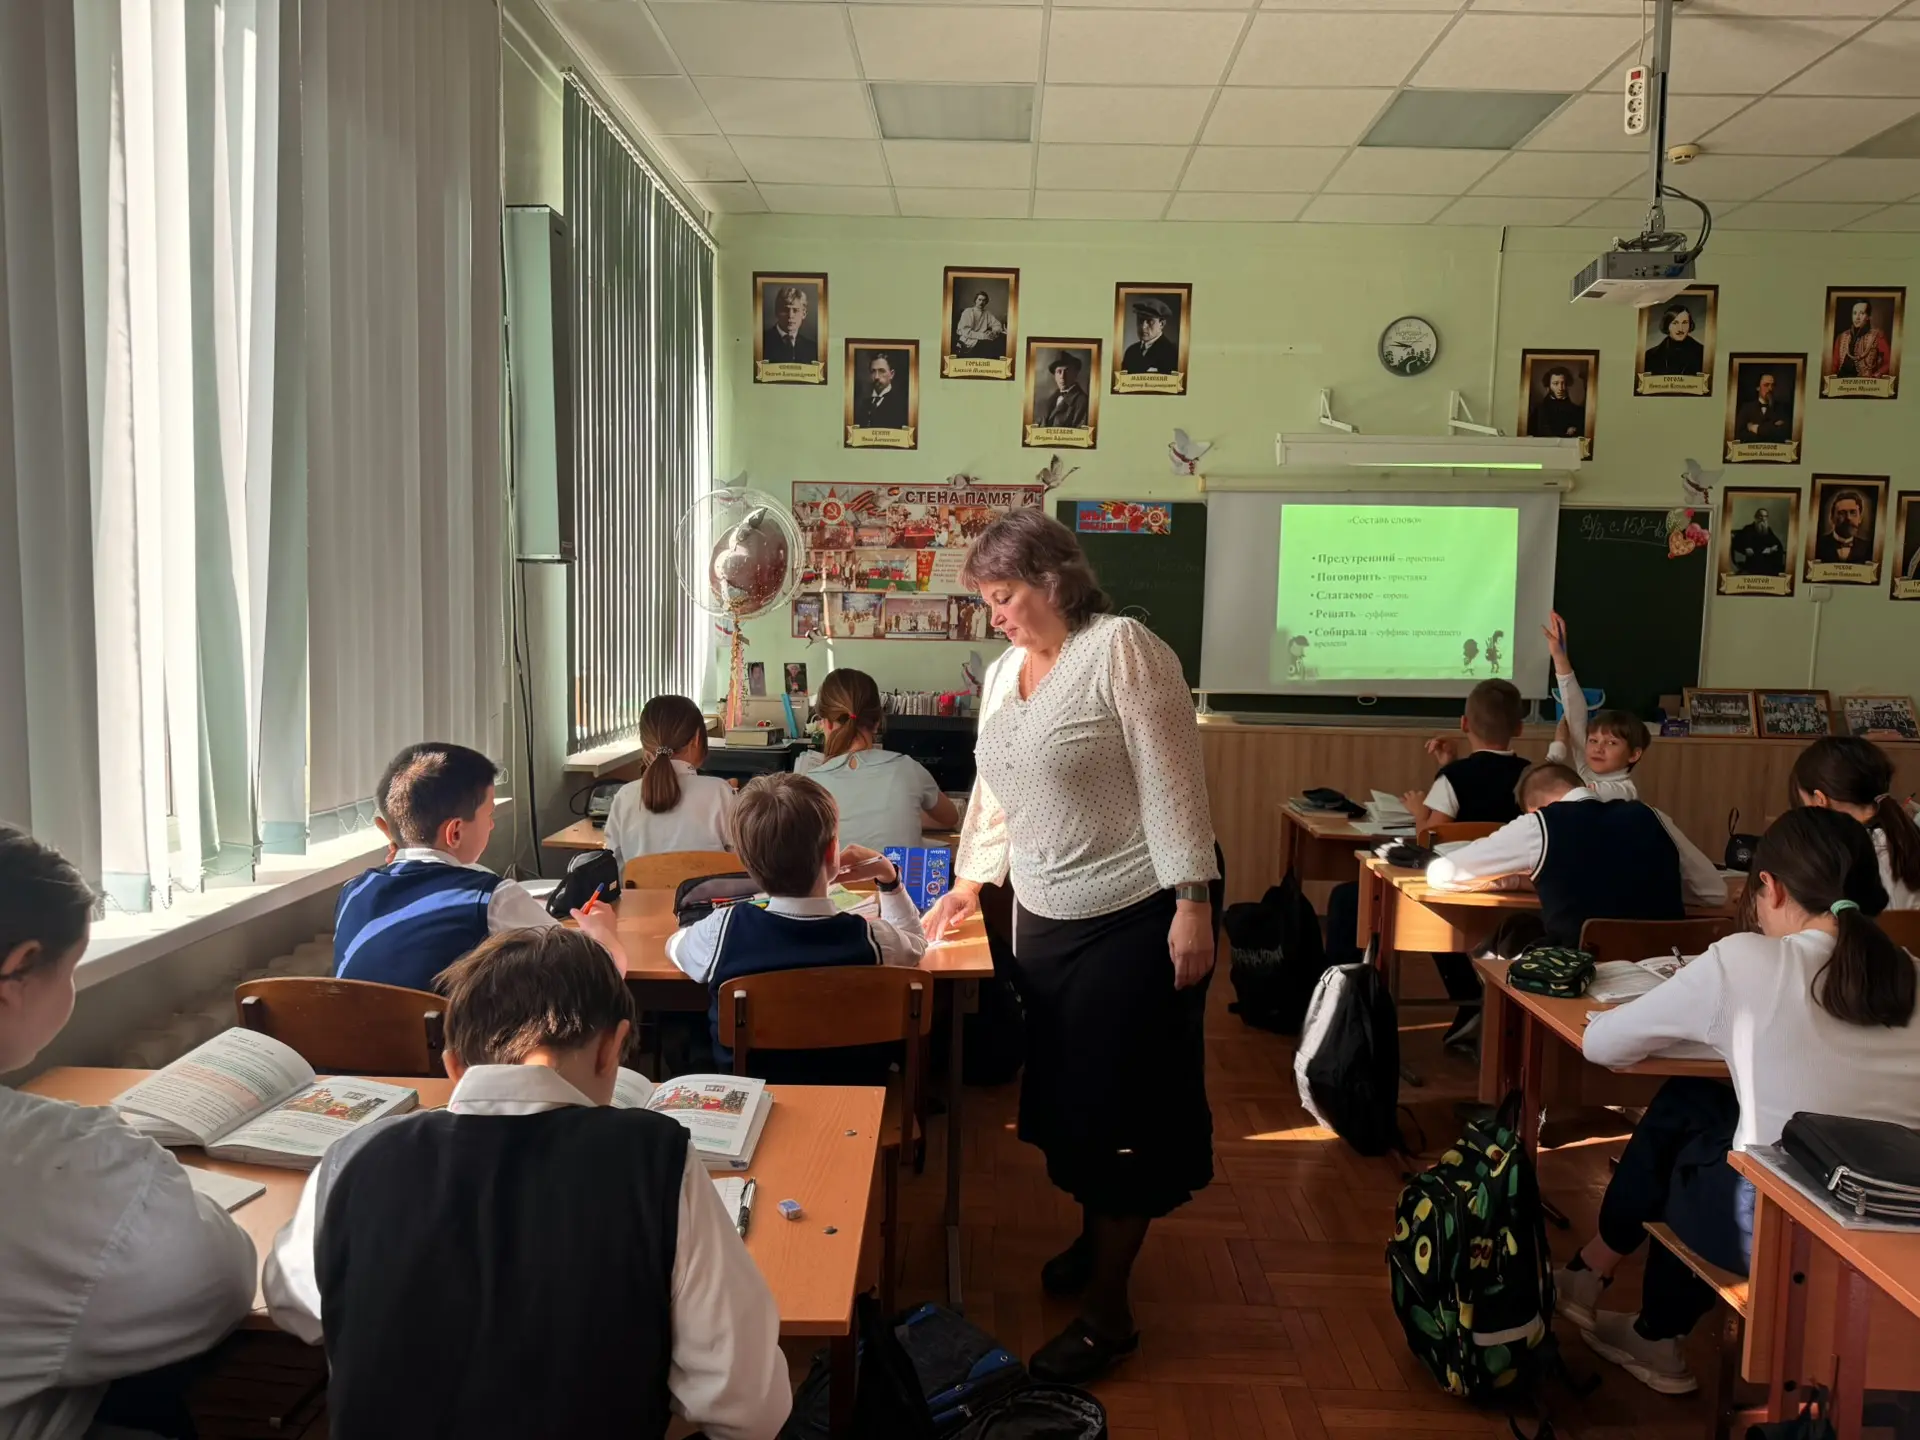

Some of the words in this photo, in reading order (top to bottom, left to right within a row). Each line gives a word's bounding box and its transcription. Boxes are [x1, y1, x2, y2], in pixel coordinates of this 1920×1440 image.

[905, 491, 959, 504] СТЕНА
[965, 492, 1034, 505] ПАМЯИ
[1318, 553, 1395, 565] Предутренний
[1317, 572, 1382, 583] Поговорить
[1316, 591, 1374, 600] Слагаемое
[1316, 609, 1356, 618] Решать
[1315, 627, 1367, 638] Собирала
